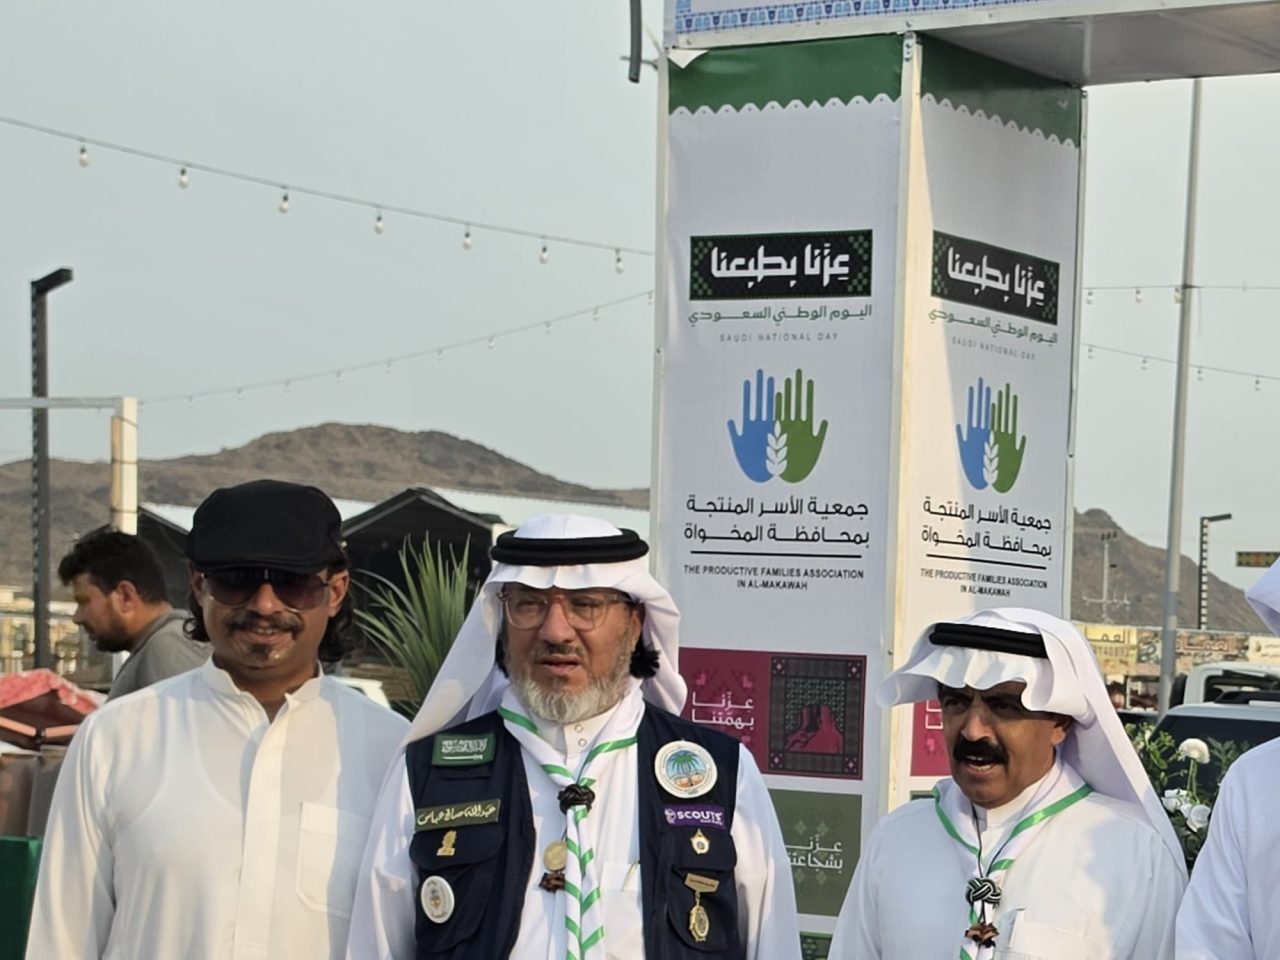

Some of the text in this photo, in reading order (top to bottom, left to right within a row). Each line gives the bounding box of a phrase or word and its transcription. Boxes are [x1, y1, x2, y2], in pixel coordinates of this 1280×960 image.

[711, 245, 797, 288] بطبعنا
[947, 247, 1010, 303] بطبعنا
[688, 304, 873, 327] اليوم الوطني السعودي
[720, 332, 839, 343] SAUDI NATIONAL DAY
[929, 309, 1058, 347] اليوم الوطني السعودي
[686, 494, 869, 521] جمعية الأسر المنتجة
[923, 496, 1052, 535] جمعية الأسر المنتجة
[684, 523, 870, 549] بمحافظة المخواة
[921, 524, 1052, 561] بمحافظة المخواة
[684, 565, 864, 579] THE PRODUCTIVE FAMILIES ASSOCIATION
[920, 568, 1048, 589] THE PRODUCTIVE FAMILIES ASSOCIATION
[737, 580, 808, 590] IN AL-MAKAWAH
[960, 585, 967, 593] IN
[1085, 626, 1131, 644] العما
[787, 852, 843, 874] بشجاعت
